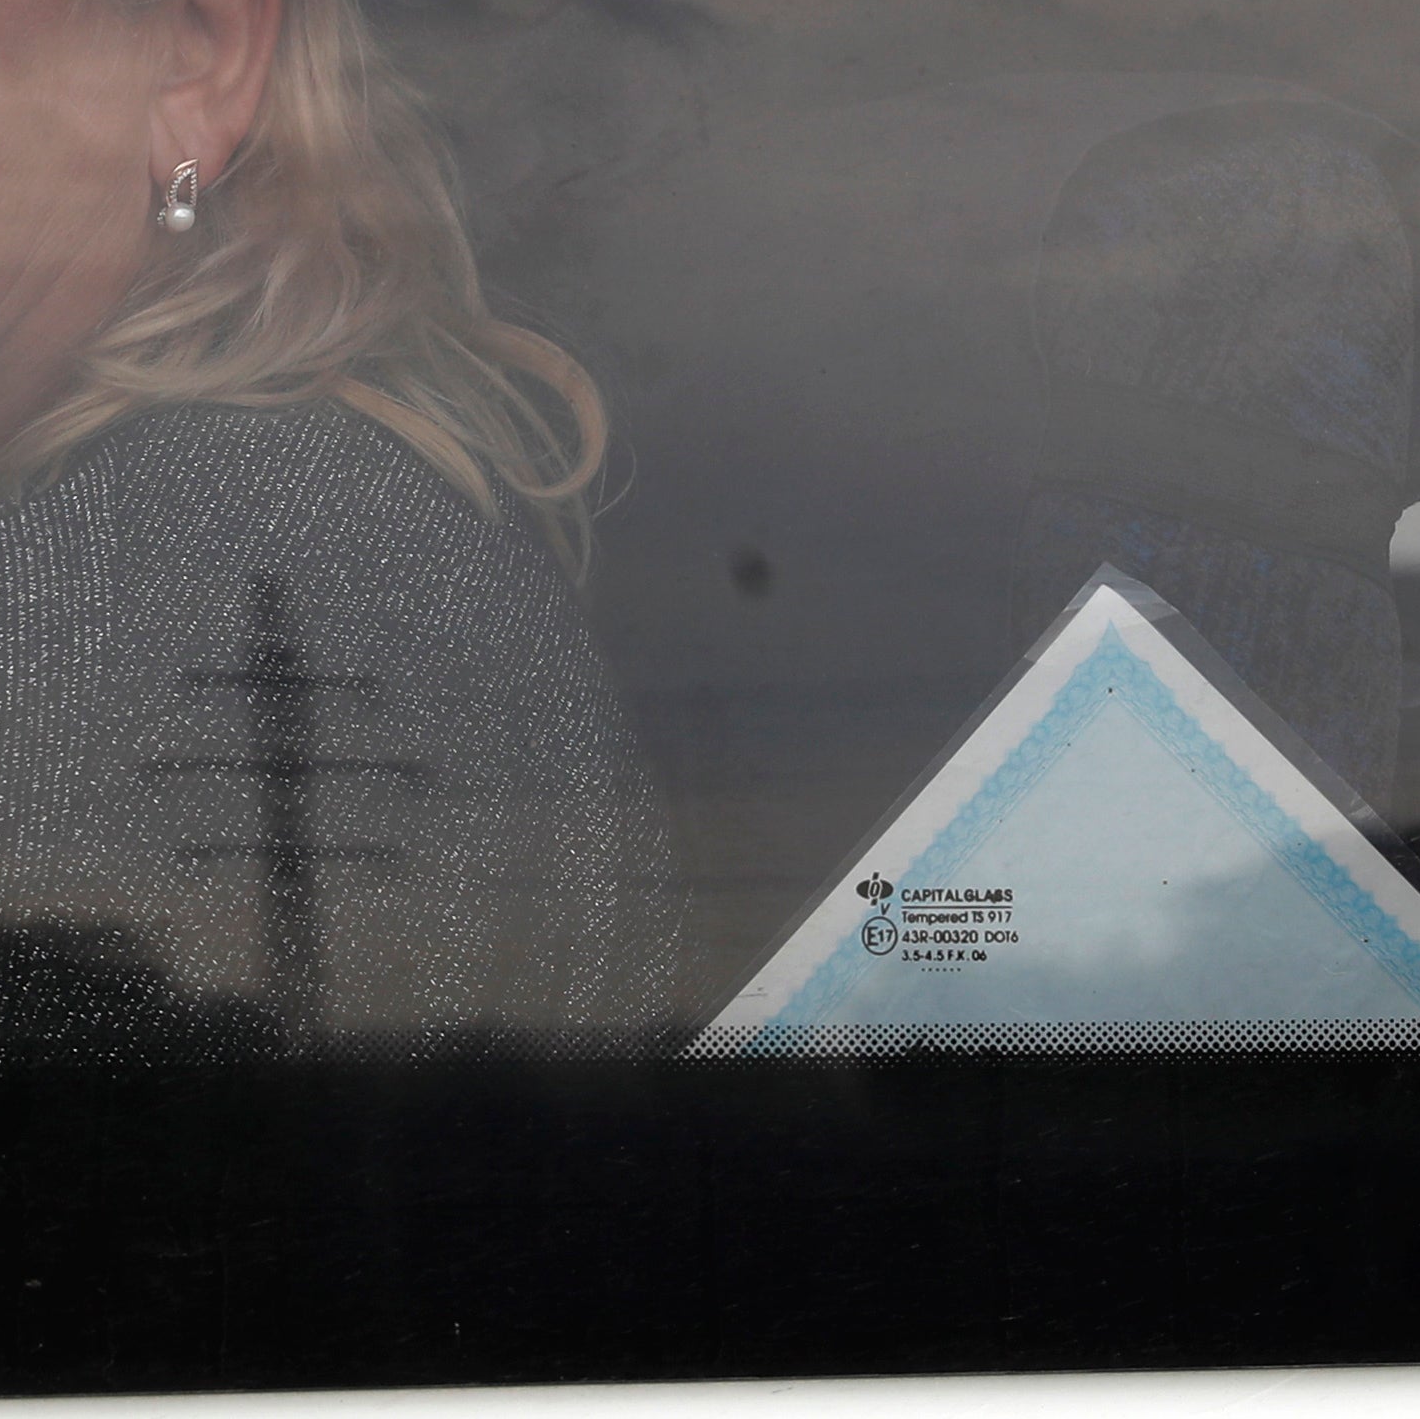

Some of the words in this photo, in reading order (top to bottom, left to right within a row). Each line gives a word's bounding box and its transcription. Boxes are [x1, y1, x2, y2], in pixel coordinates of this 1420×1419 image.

[901, 911, 968, 926] Tempered
[987, 911, 1012, 923] 917
[901, 930, 979, 944] 43R-00320
